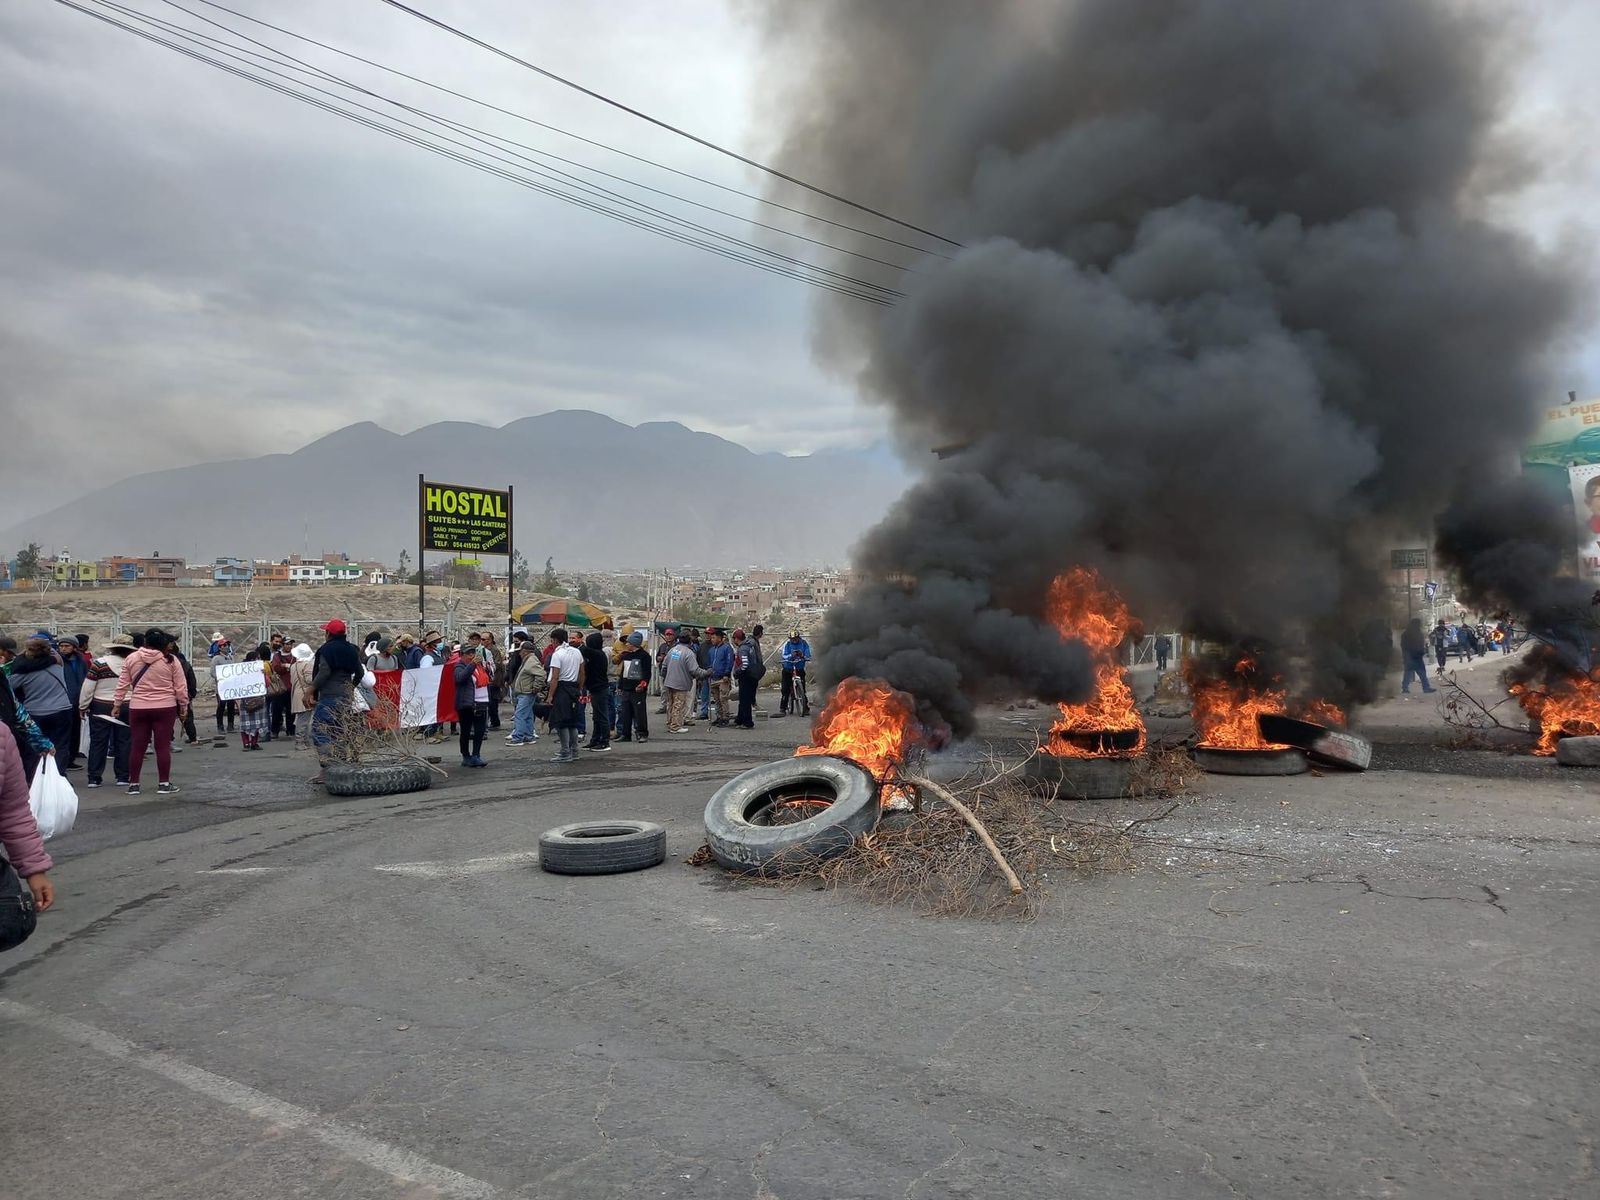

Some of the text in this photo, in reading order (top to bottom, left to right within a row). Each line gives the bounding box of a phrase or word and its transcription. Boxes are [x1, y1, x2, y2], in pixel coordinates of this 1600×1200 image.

[426, 488, 506, 518] HOSTAL
[428, 515, 456, 524] SUITES
[482, 532, 507, 551] EVENTOS
